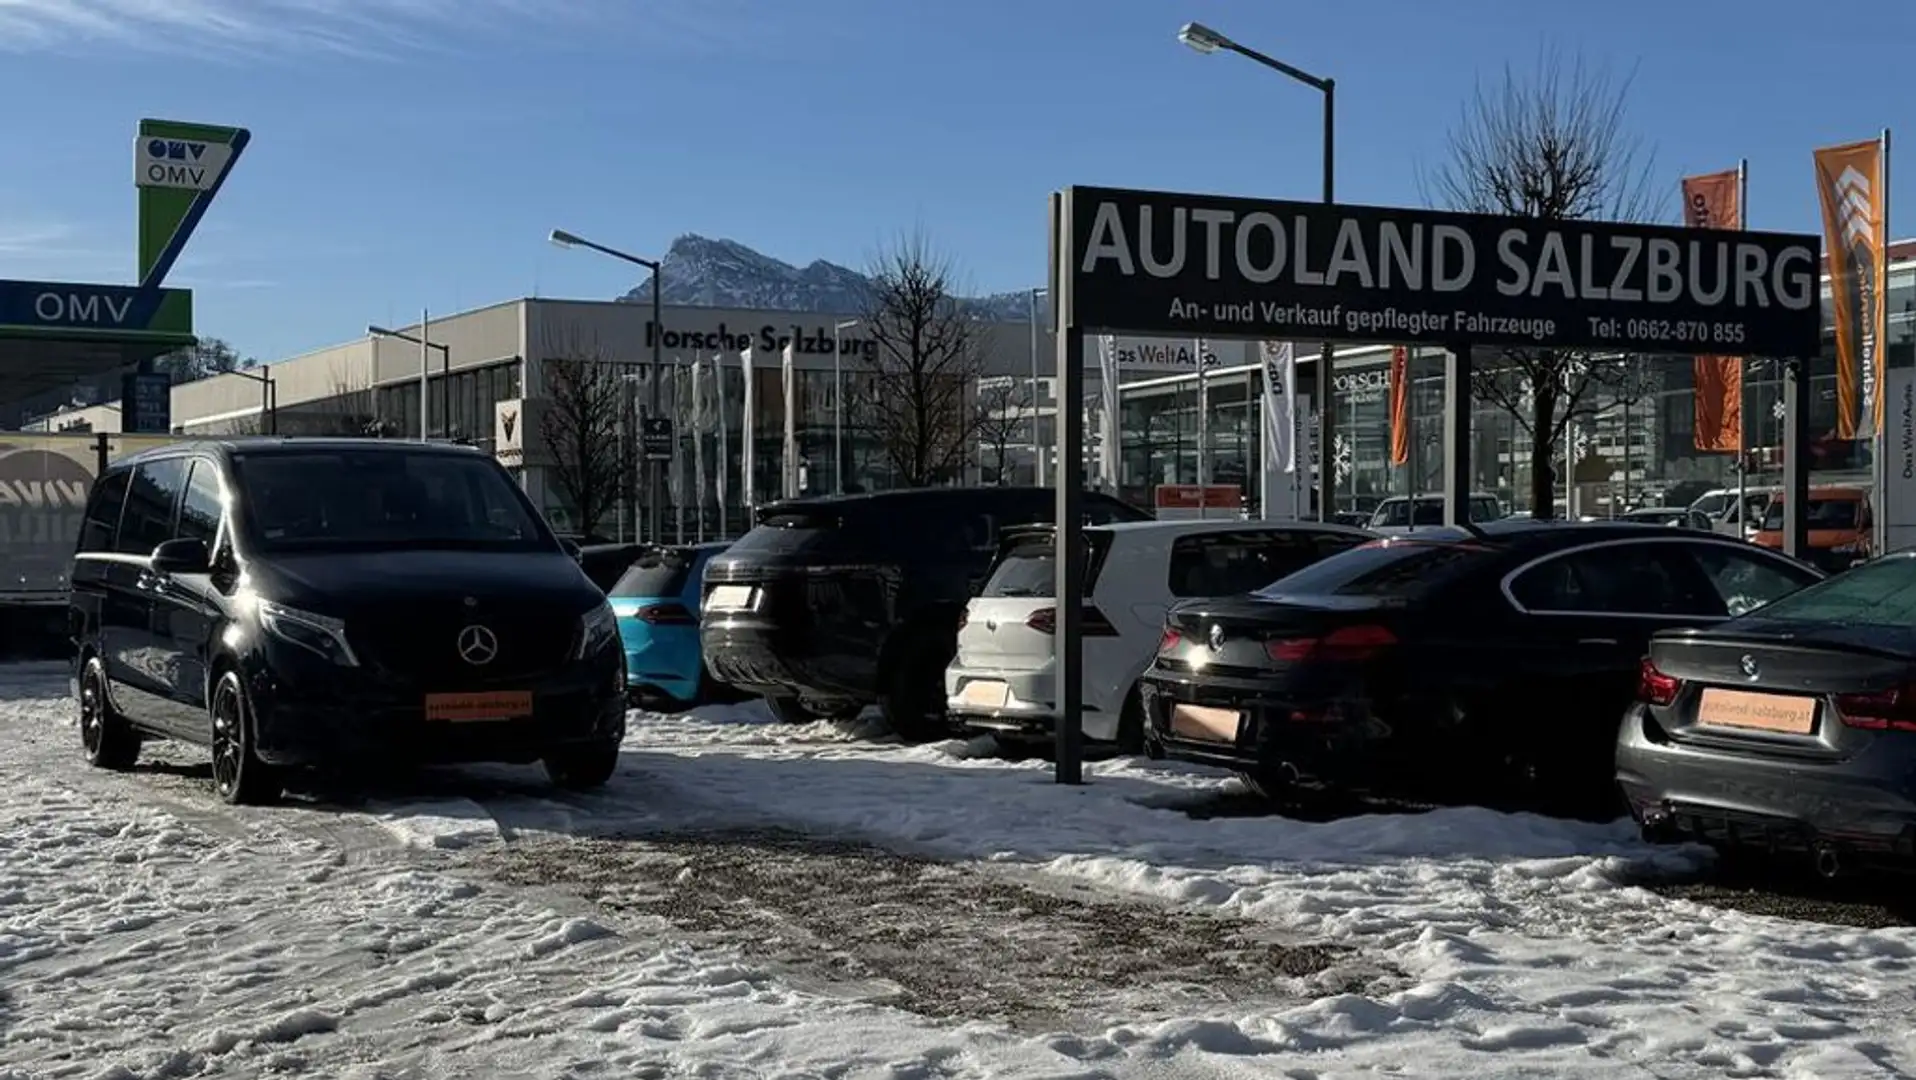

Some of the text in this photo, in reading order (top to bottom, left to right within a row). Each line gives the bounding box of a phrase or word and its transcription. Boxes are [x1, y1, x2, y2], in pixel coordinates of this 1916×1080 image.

[147, 164, 206, 184] OMV
[1081, 202, 1812, 309] AUTOLAND SALZBURG
[36, 292, 133, 321] OMV
[1169, 298, 1746, 342] An- und Verkauf gepflegter Fahrzeuge Tel: 0662-870 855
